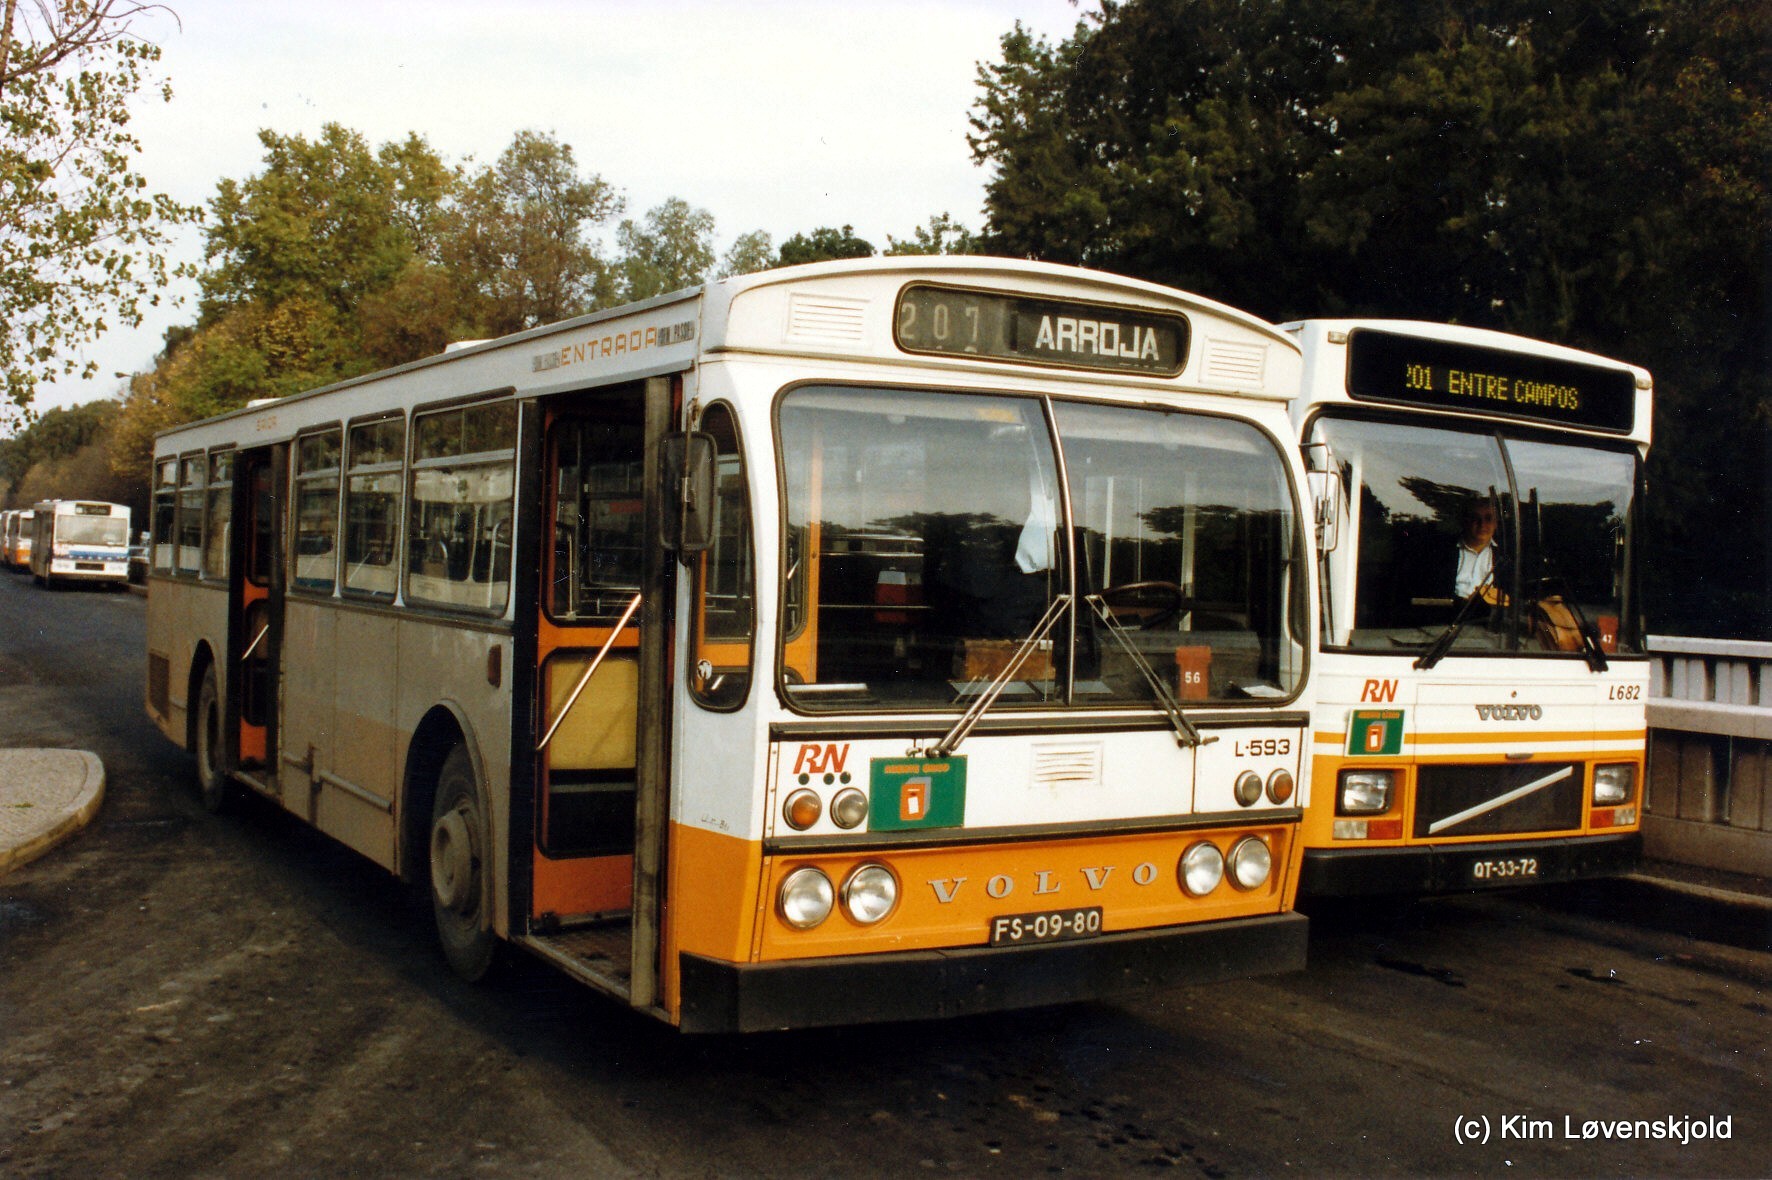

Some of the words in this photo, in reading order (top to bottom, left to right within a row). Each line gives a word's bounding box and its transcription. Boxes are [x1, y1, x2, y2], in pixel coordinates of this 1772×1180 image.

[561, 327, 657, 367] ENTRADA
[1035, 315, 1160, 361] ARROJA
[1449, 369, 1508, 401] ENTRE
[1514, 380, 1578, 410] CAMPOS
[1185, 671, 1201, 684] 56
[1360, 679, 1399, 702] RN
[1608, 685, 1641, 700] L682
[1475, 704, 1543, 721] VOLVO
[792, 743, 850, 775] RN
[927, 862, 1158, 904] VOLVO
[994, 911, 1100, 942] FS-09-80
